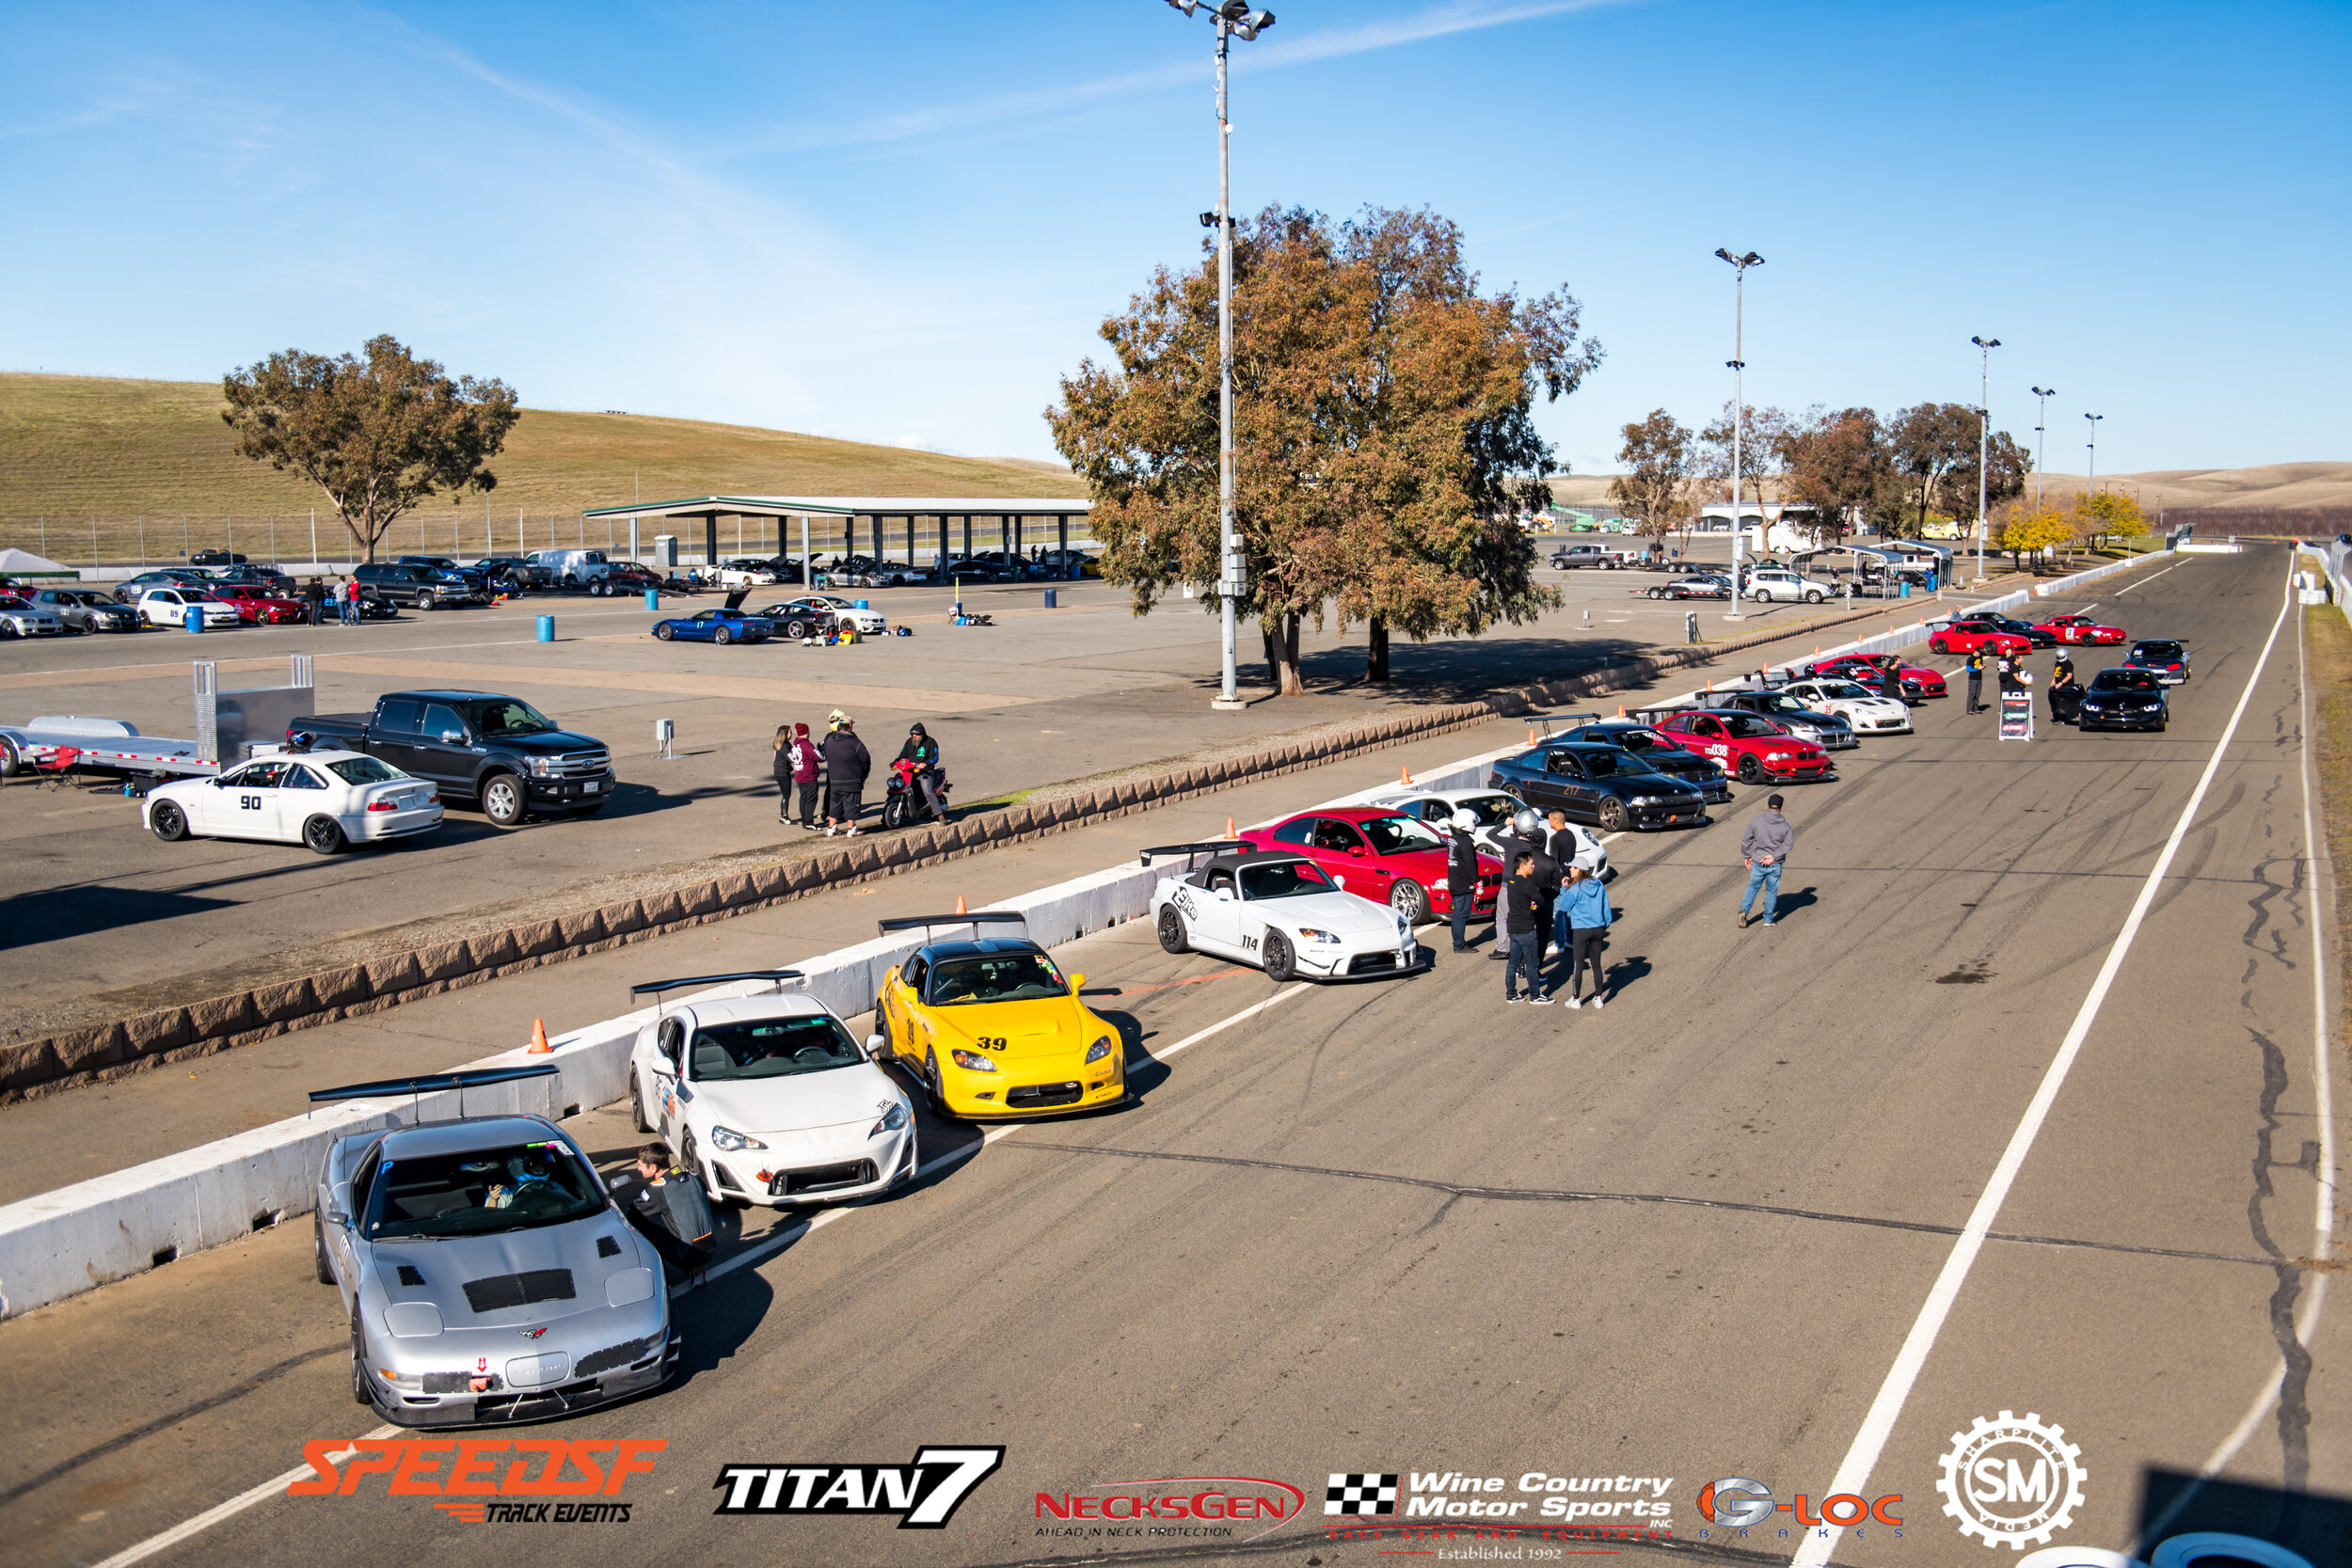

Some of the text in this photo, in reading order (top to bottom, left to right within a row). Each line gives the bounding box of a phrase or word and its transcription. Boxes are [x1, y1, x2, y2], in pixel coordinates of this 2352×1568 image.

[1563, 784, 1580, 797] 217
[241, 796, 262, 810] 90
[1242, 934, 1259, 951] 114
[977, 1037, 1007, 1051] 39
